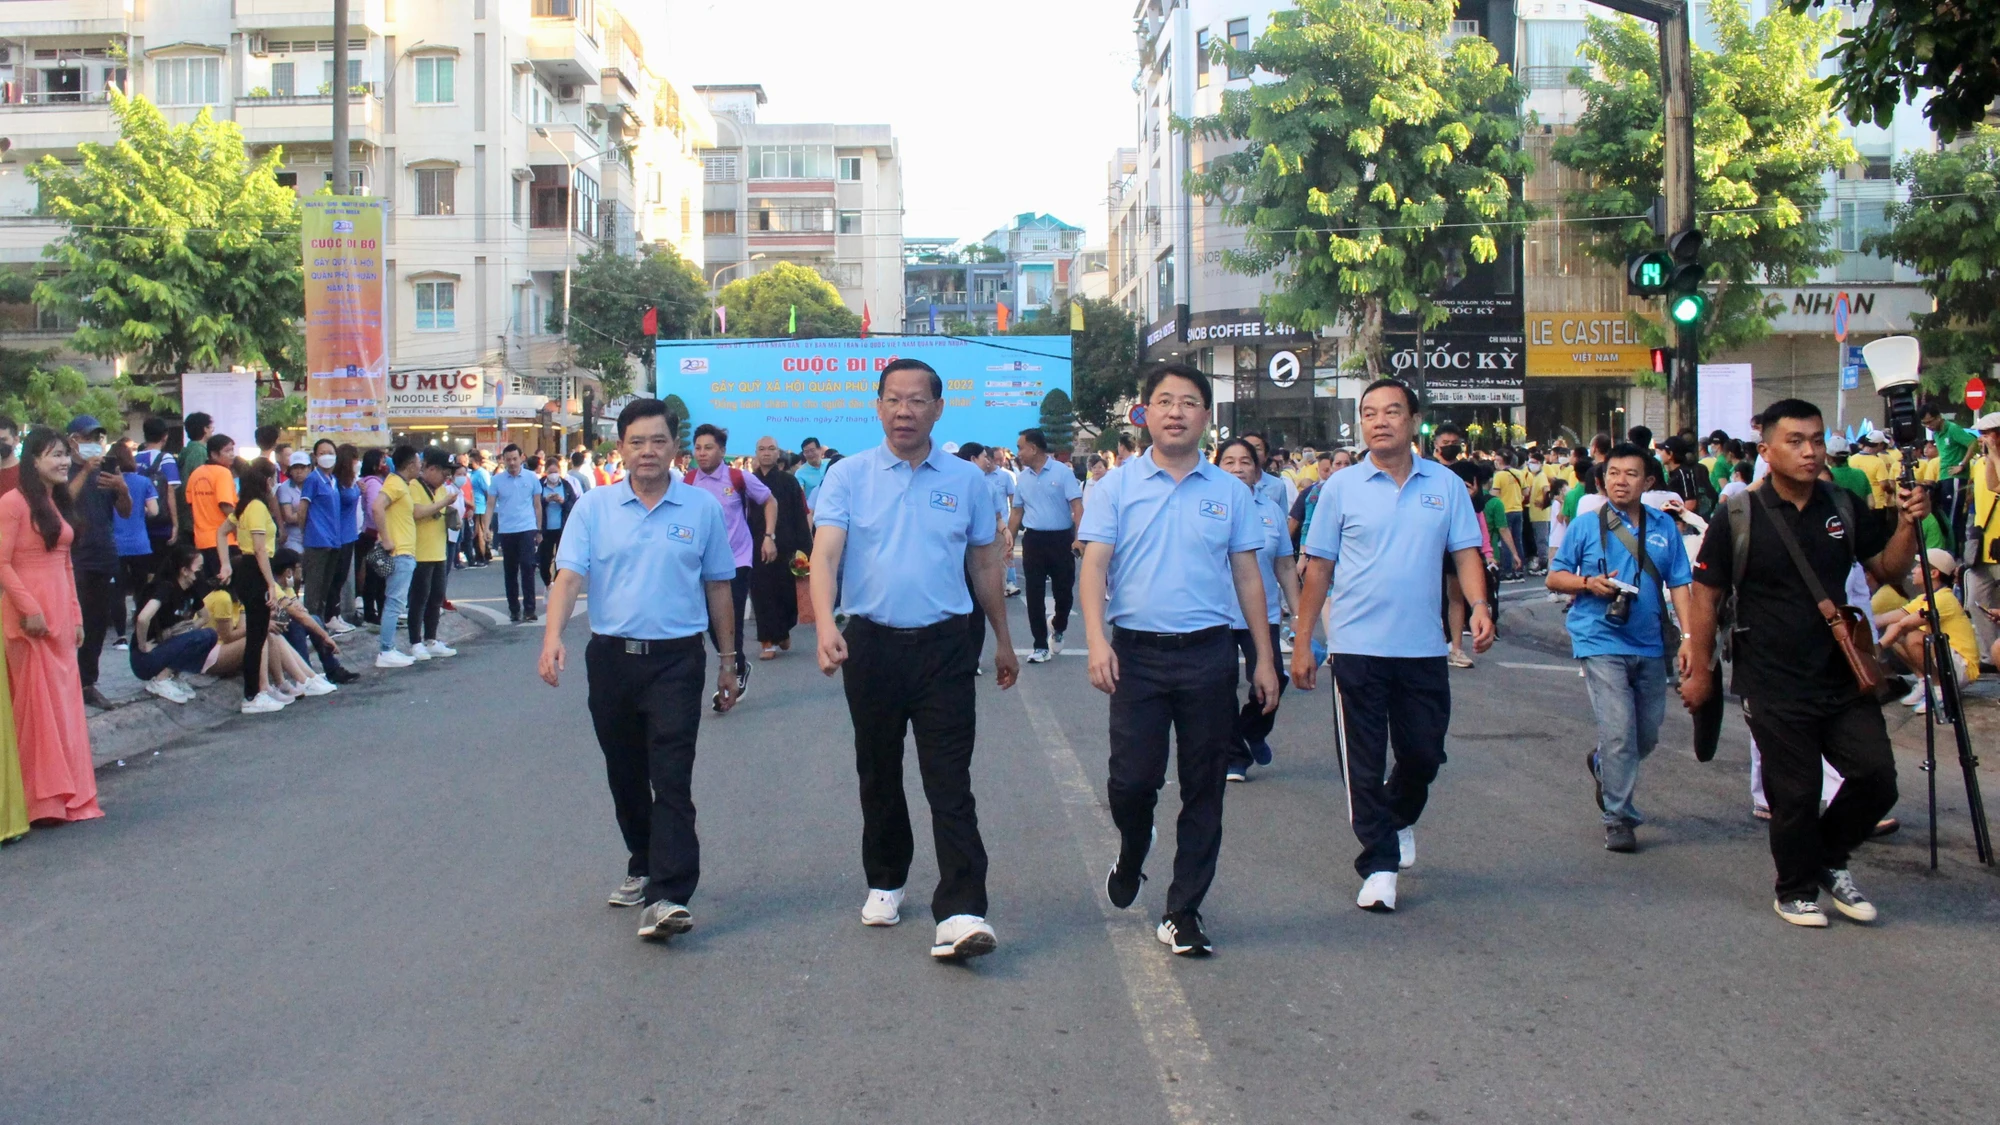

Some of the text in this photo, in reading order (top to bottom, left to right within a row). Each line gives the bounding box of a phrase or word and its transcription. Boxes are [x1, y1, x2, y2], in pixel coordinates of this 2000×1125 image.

[311, 238, 342, 250] CUỘC
[1447, 305, 1472, 315] UỐC
[1187, 325, 1207, 343] SNOB
[1209, 322, 1261, 339] COFFEE
[1531, 320, 1641, 345] LE CASTELL
[783, 355, 838, 375] CUỘC
[847, 357, 867, 372] ĐI
[1476, 346, 1519, 369] KỲ
[1572, 353, 1619, 364] VIỆT NAM
[416, 370, 478, 395] MỰC
[785, 378, 805, 394] HỘI
[808, 379, 842, 394] QUẬN
[947, 379, 974, 391] 2022
[394, 394, 439, 403] NOODLE
[443, 394, 472, 403] SOUP
